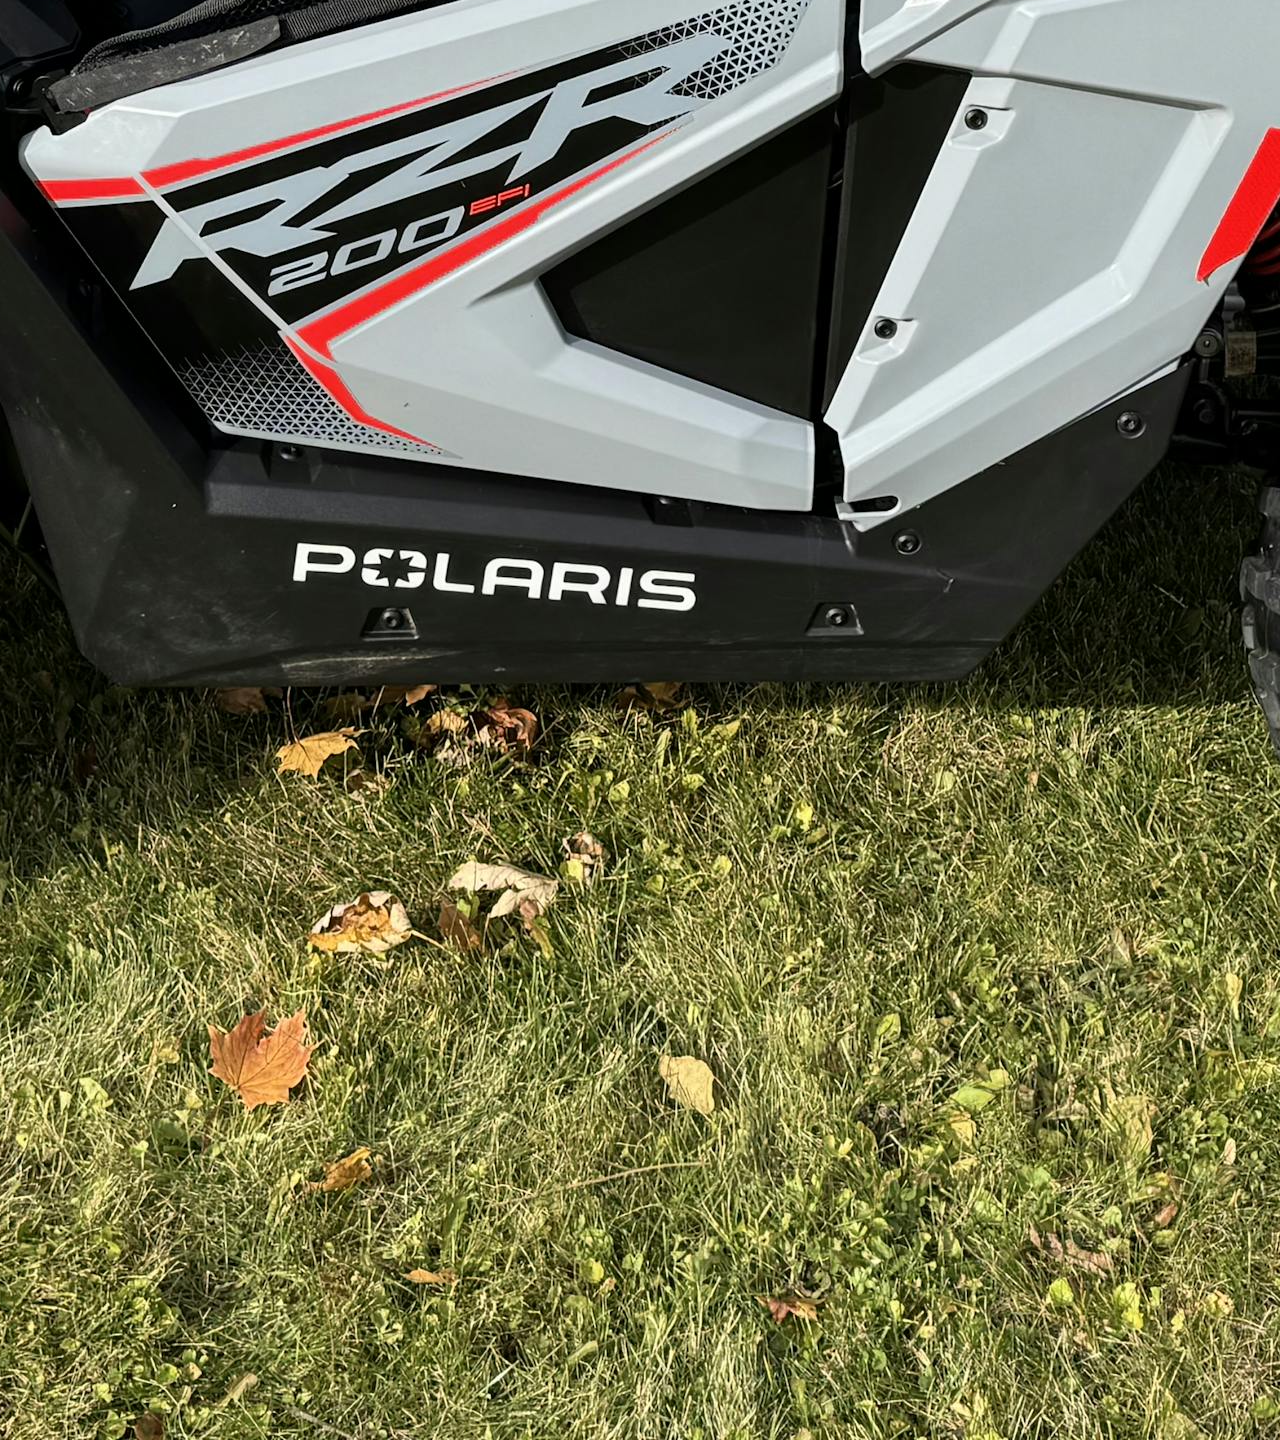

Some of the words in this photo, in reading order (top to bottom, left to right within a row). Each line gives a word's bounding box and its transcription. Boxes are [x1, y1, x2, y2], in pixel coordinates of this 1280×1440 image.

[130, 33, 734, 290] RZR
[268, 206, 466, 297] 200
[469, 183, 531, 216] EFI
[292, 542, 697, 612] POLARIS
